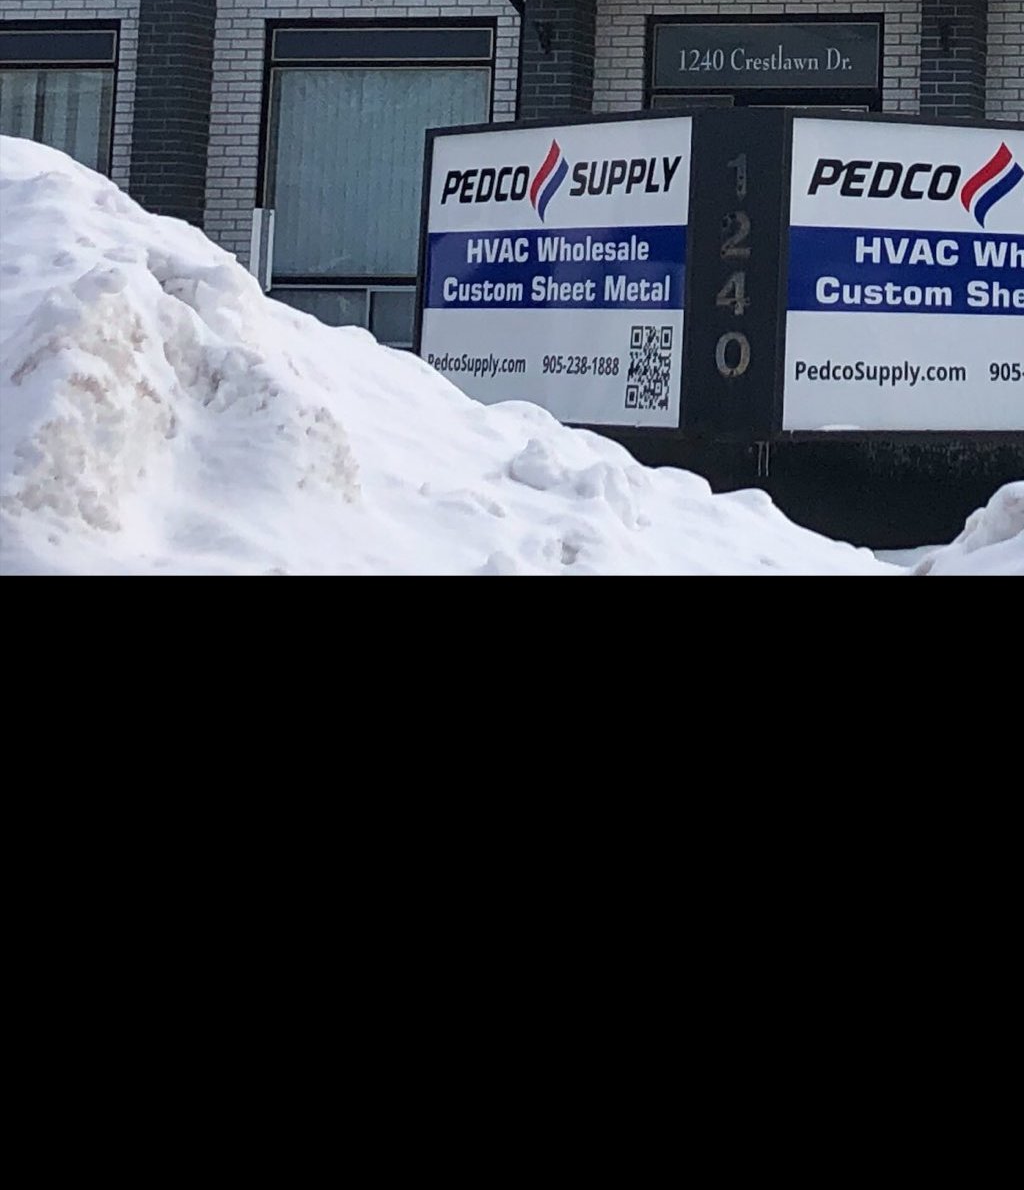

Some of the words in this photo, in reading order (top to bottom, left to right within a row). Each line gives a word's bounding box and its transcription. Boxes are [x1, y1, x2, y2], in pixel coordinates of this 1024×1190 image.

[678, 48, 725, 72] 1240
[730, 44, 820, 72] Crestlawn
[825, 47, 853, 71] Dr.
[440, 165, 531, 205] PEDCO
[569, 155, 682, 197] SUPPLY
[807, 158, 962, 201] PEDCO
[466, 236, 529, 264] HVAC
[536, 234, 650, 263] Wholesale
[855, 236, 959, 267] HVAC
[442, 276, 524, 302] Custom
[531, 275, 597, 302] Sheet
[604, 274, 671, 302] Metal
[815, 276, 953, 307] Custom
[427, 352, 527, 378] PedcoSupply.com
[542, 354, 620, 376] 905-238-1888
[794, 360, 967, 387] PedcoSupply.com
